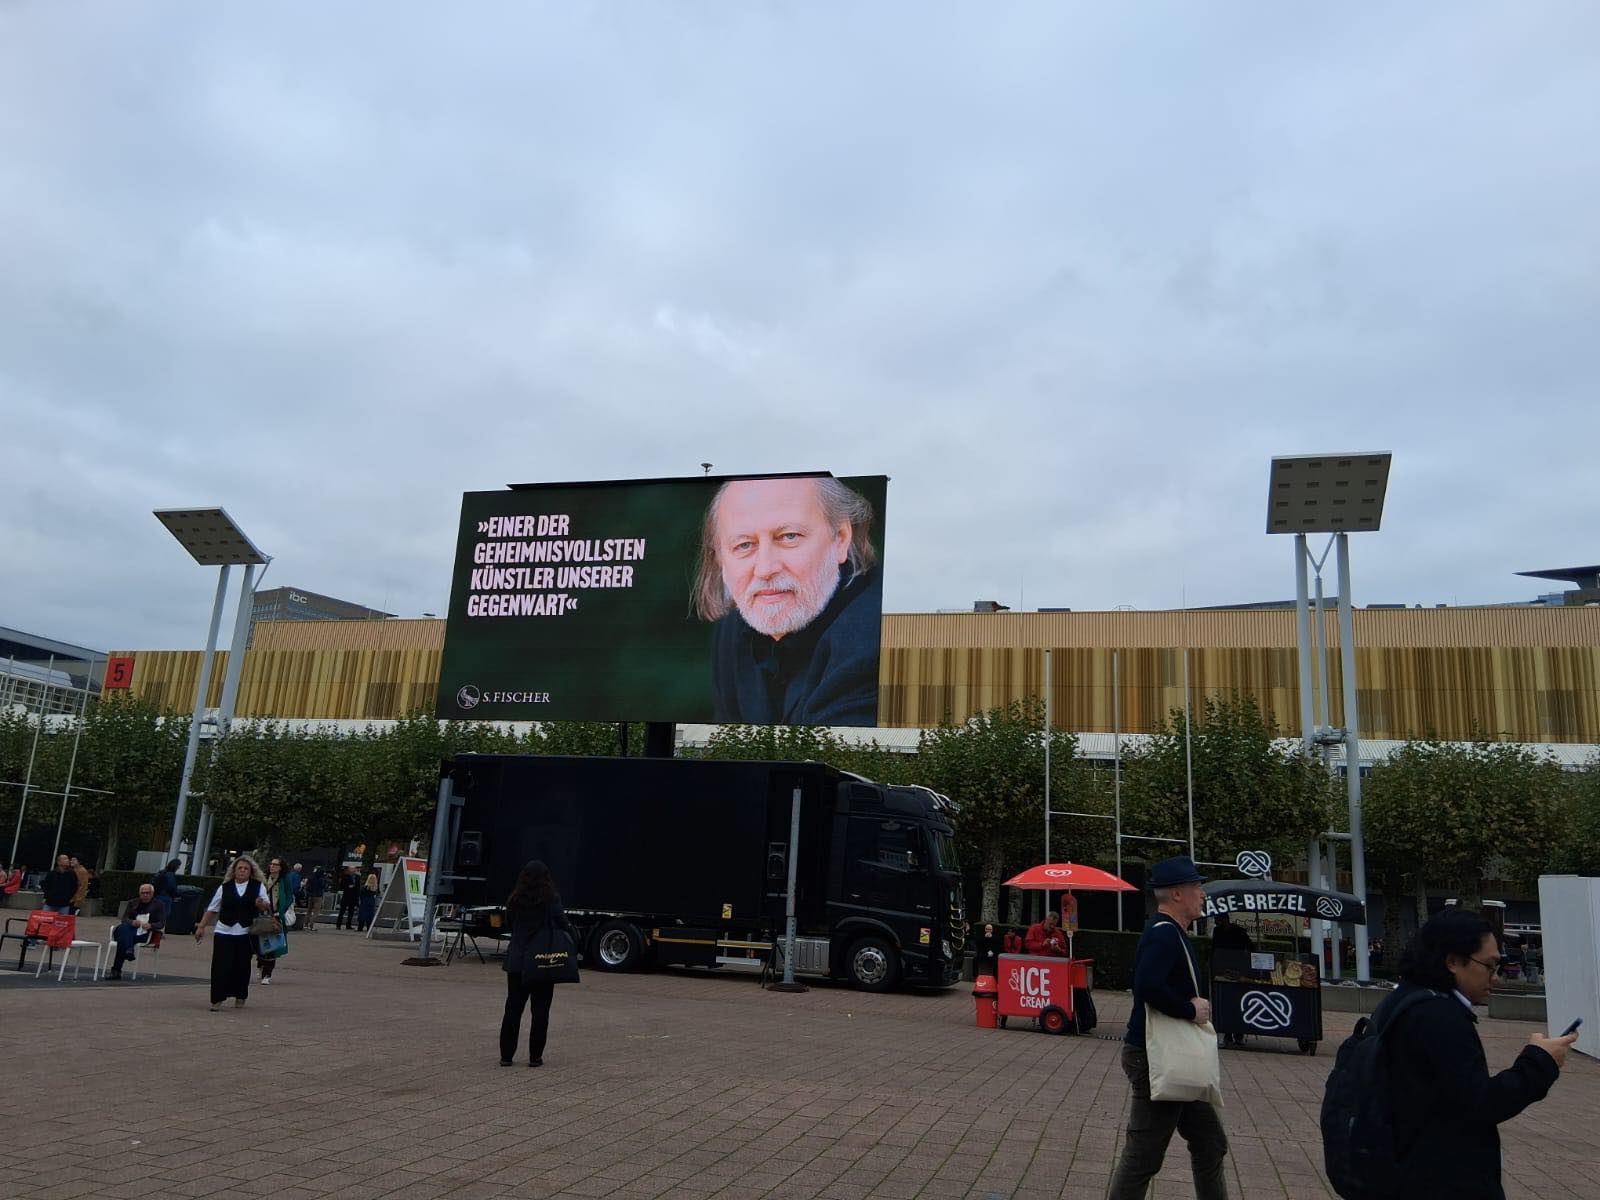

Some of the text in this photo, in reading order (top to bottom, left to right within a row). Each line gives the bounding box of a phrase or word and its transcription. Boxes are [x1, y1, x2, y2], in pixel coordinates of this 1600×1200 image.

[477, 514, 570, 537] »EINER DER
[474, 538, 646, 563] GEHEIMNISVOLLSTEN
[470, 564, 634, 590] KÜNSTLER UNSERER
[289, 591, 308, 604] ibc
[467, 593, 578, 617] GEGENWART«
[113, 663, 126, 682] 5
[482, 691, 551, 703] S. FISCHER
[1020, 966, 1051, 997] ICE
[1020, 996, 1051, 1009] CREAM
